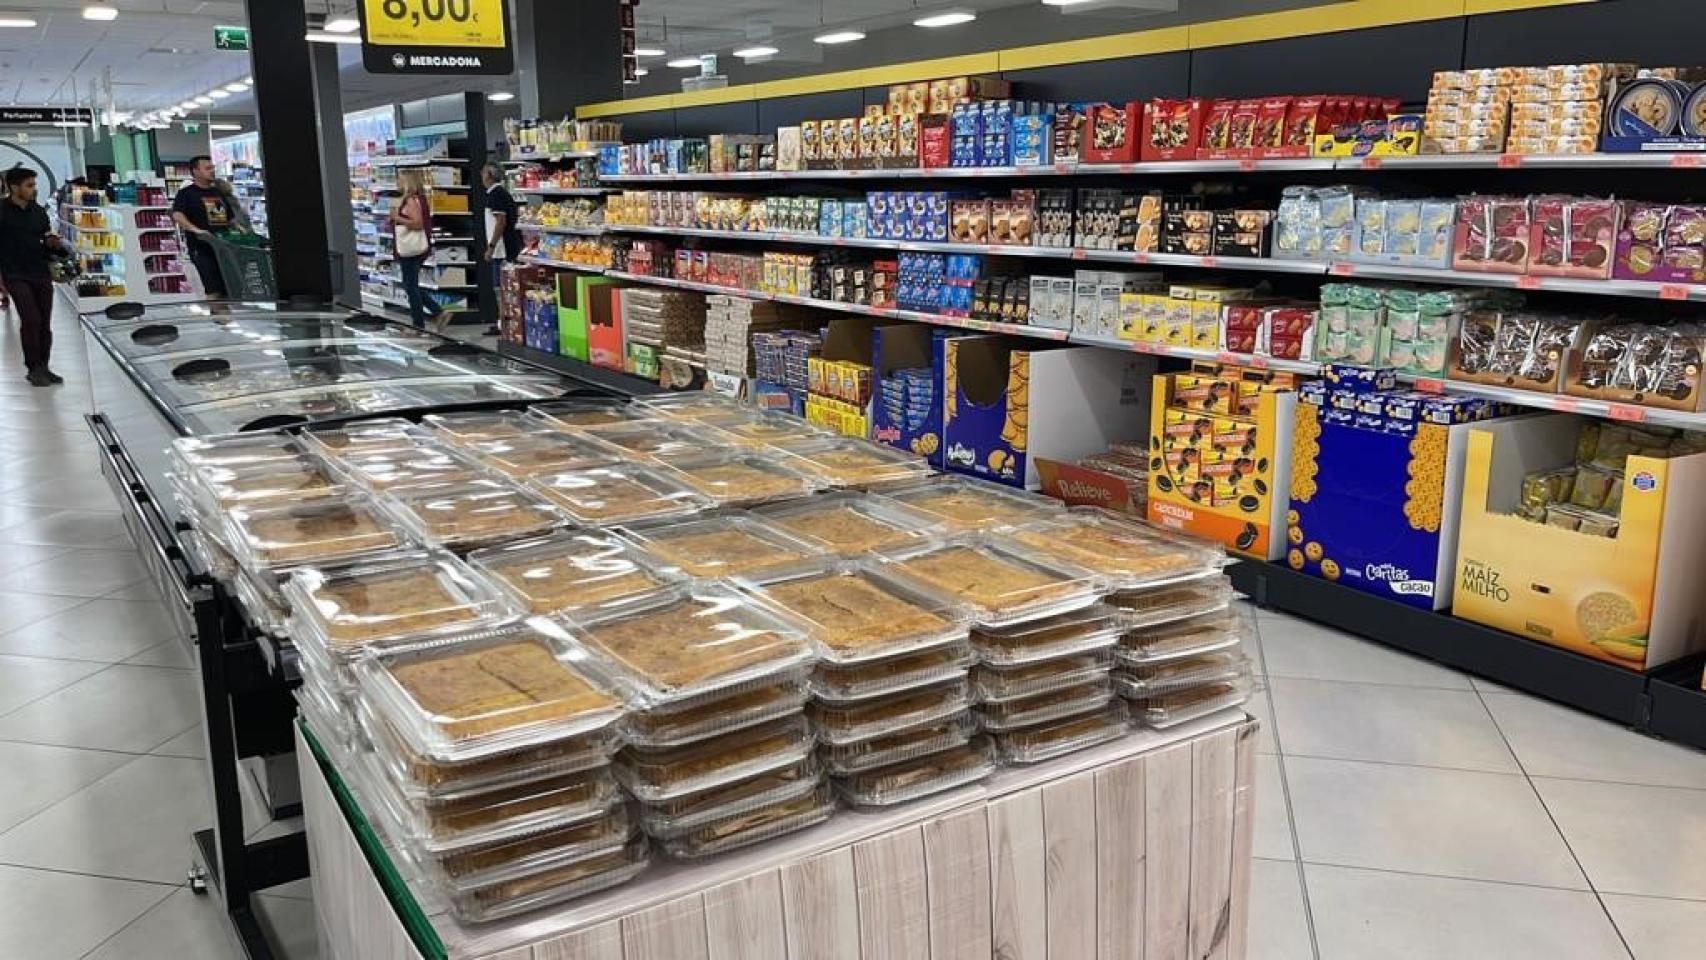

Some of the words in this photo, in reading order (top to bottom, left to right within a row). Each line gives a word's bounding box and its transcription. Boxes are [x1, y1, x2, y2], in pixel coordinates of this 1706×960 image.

[409, 56, 482, 67] MERCADONA
[1463, 564, 1500, 587] MAÍZ
[1400, 582, 1431, 593] cacao
[1462, 578, 1510, 602] MILHO
